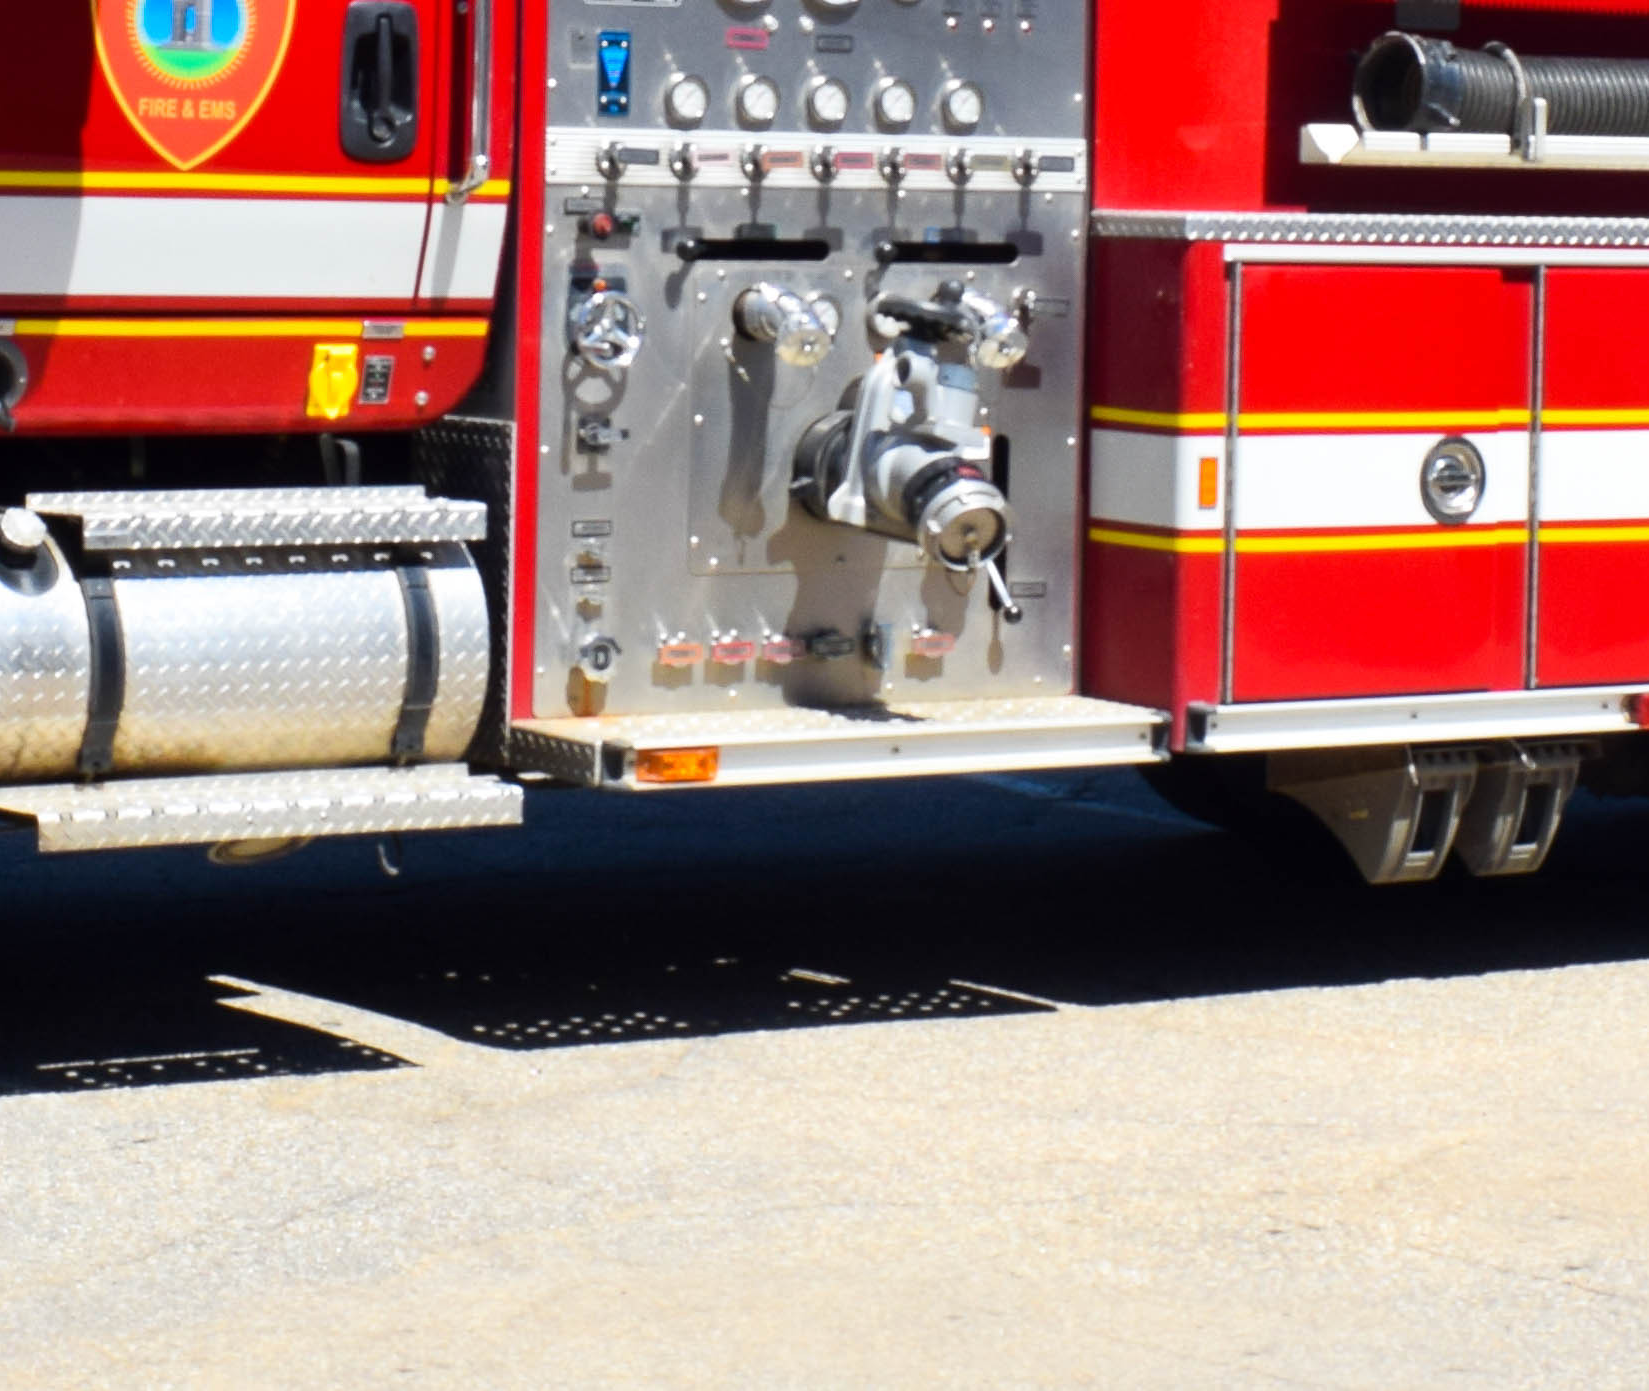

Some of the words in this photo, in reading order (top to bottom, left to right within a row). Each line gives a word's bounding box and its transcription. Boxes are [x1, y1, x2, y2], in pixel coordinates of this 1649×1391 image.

[138, 97, 178, 118] FIRE
[182, 99, 195, 119] &
[199, 99, 236, 120] EMS
